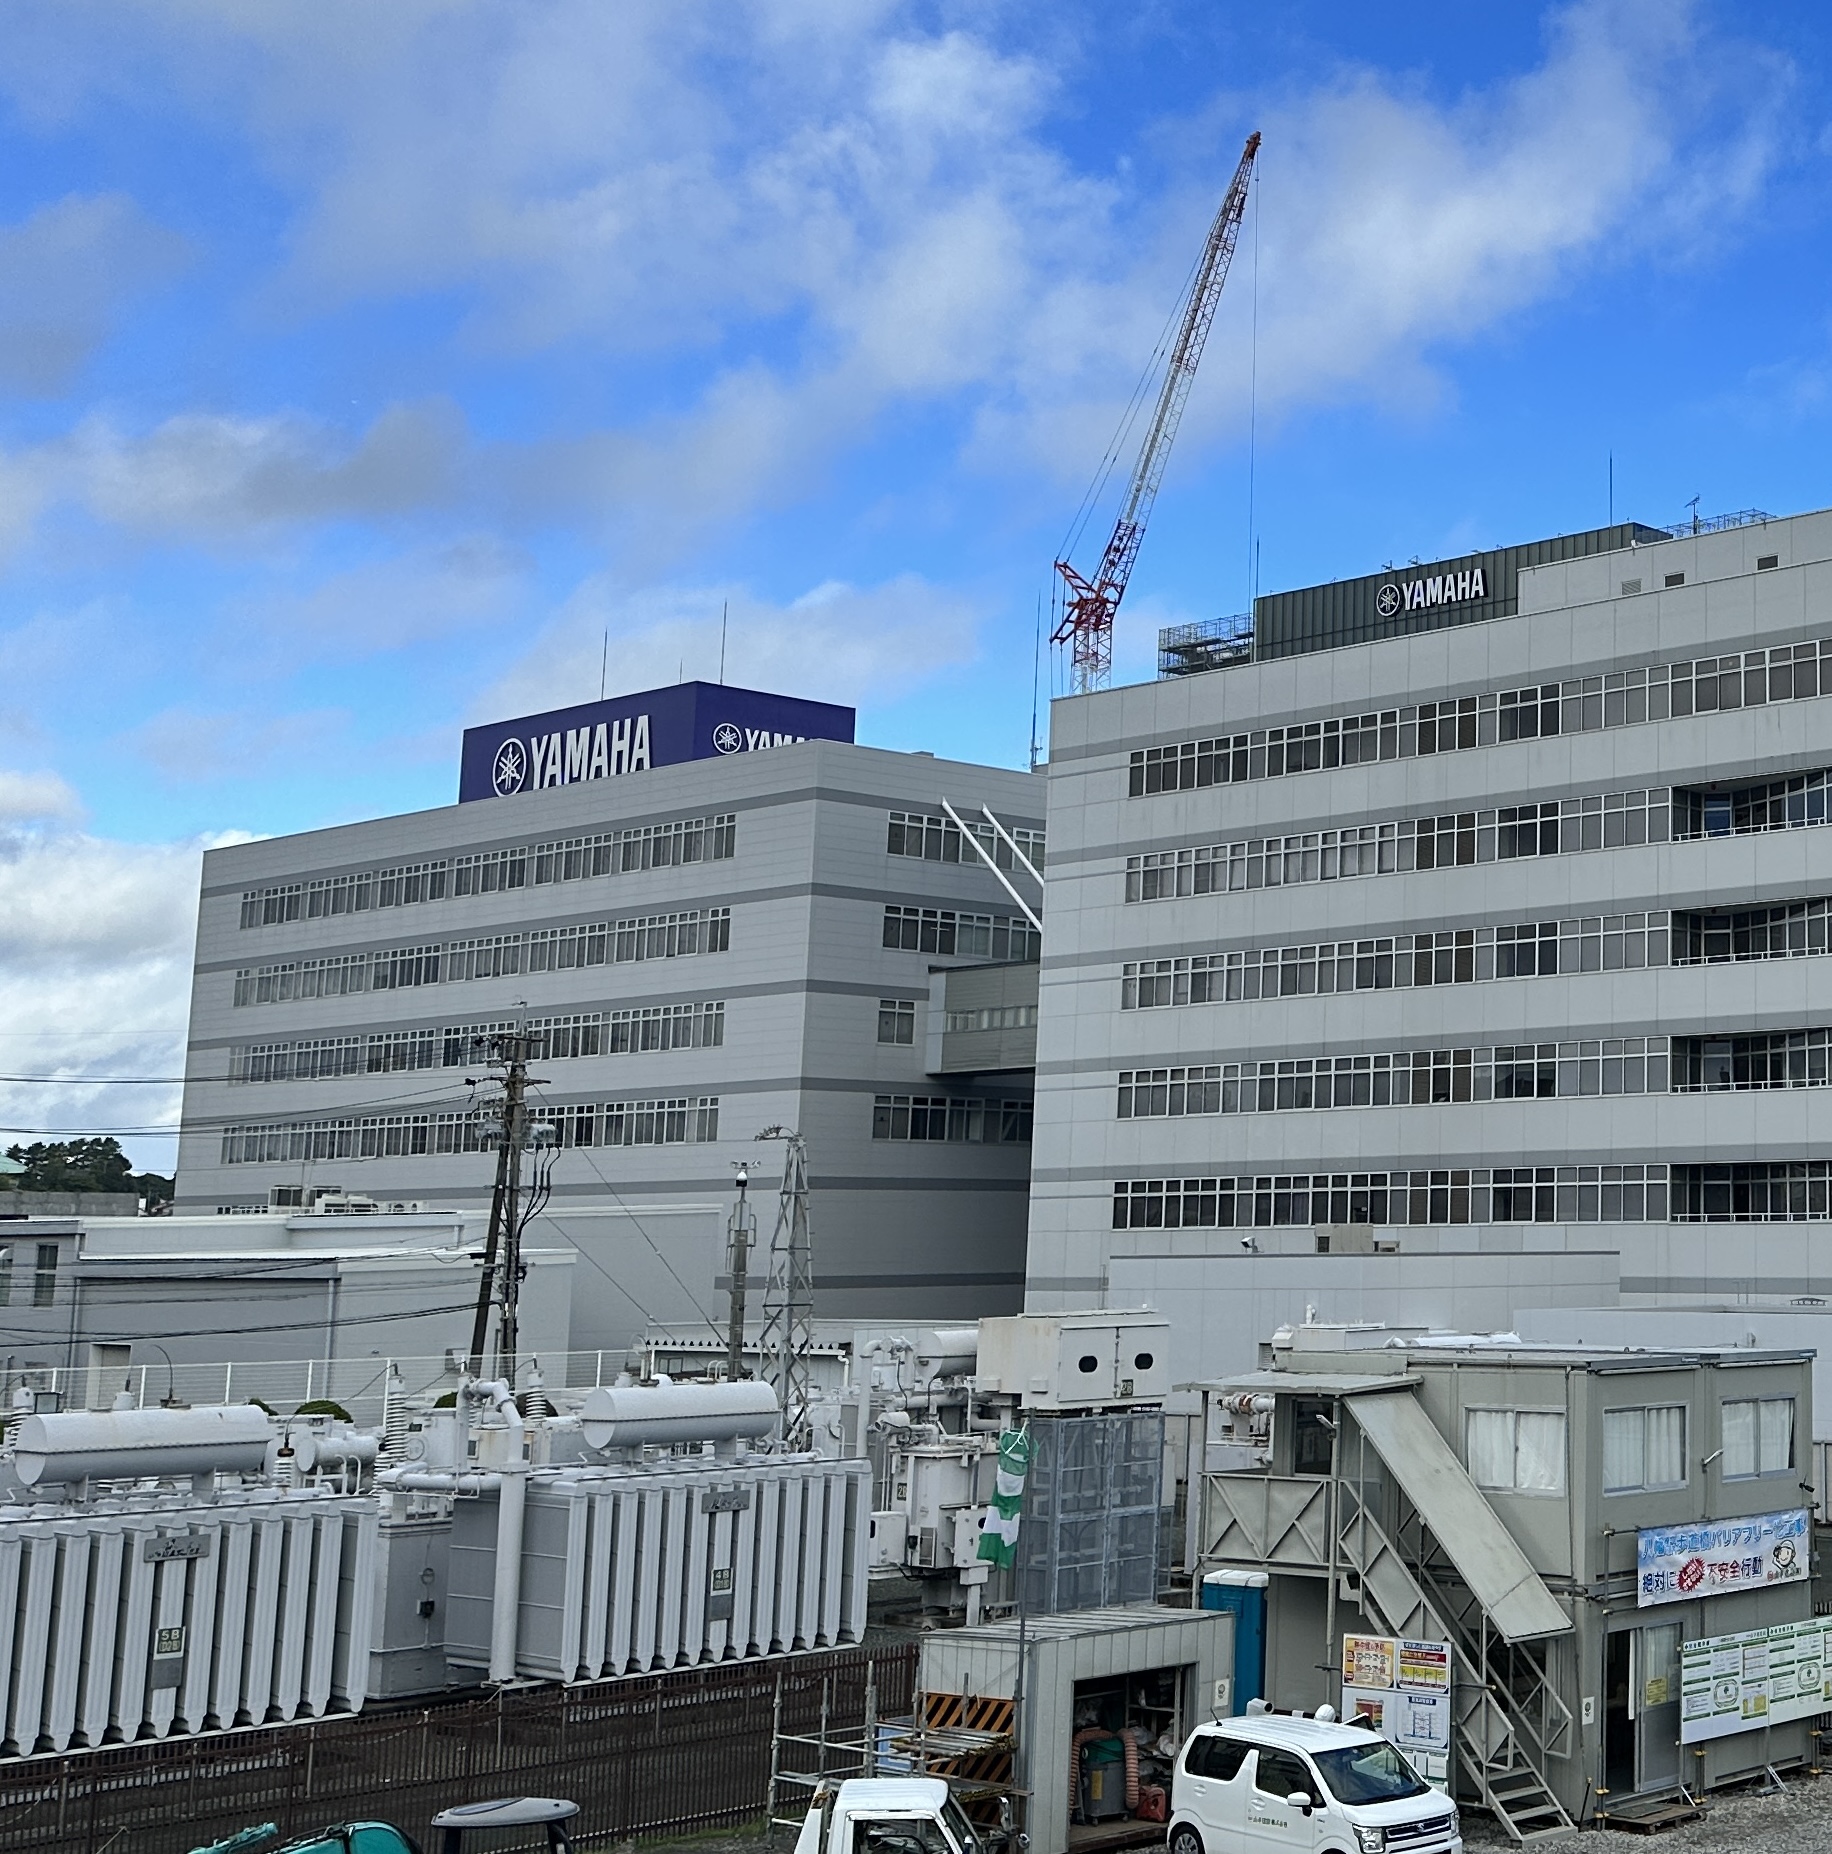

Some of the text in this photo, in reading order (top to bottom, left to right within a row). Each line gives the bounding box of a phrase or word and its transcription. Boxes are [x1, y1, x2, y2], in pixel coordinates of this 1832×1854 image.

[1402, 568, 1484, 610] YAMAHA
[531, 714, 650, 790] YAMAHA
[161, 1629, 180, 1641] 5B
